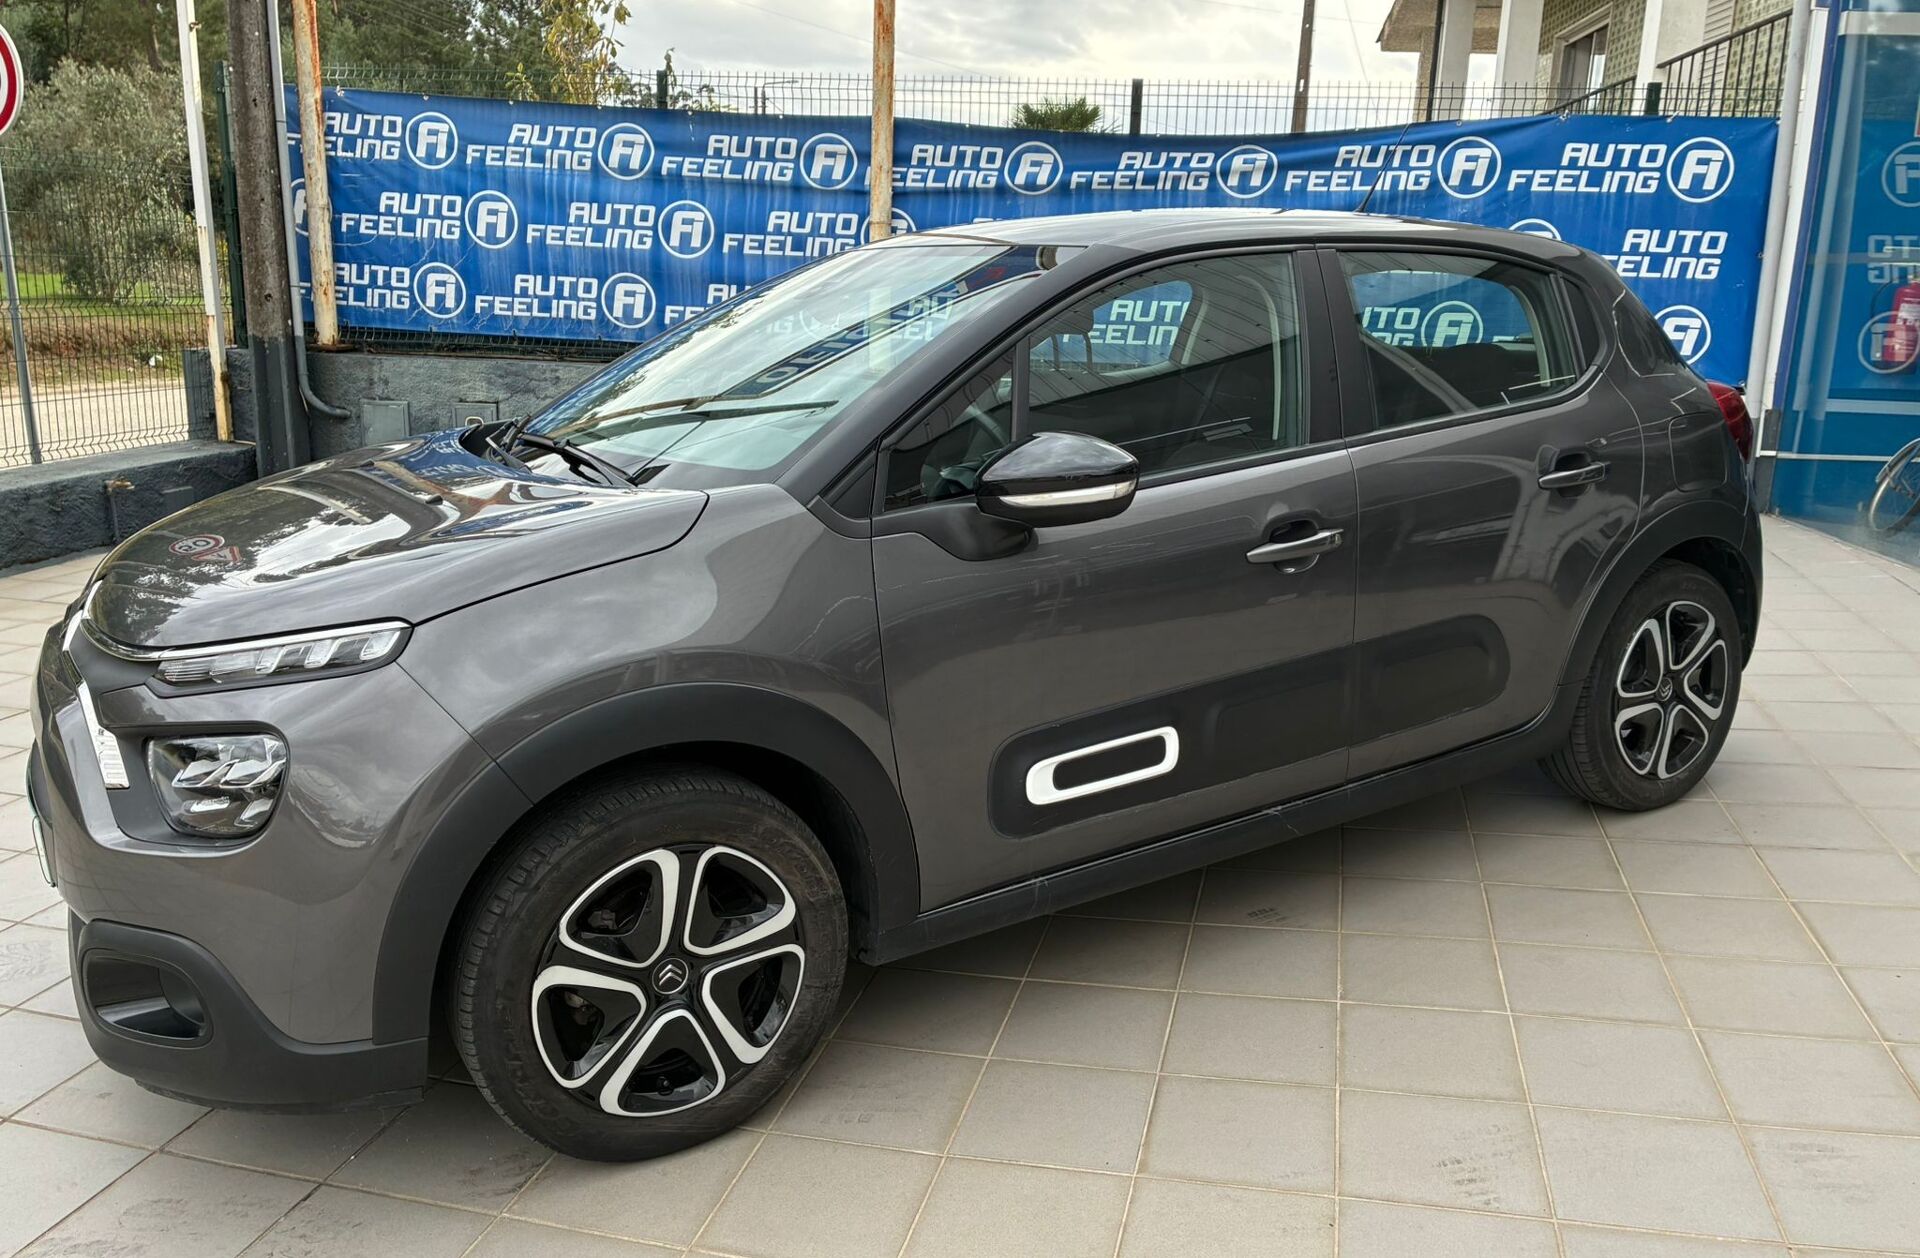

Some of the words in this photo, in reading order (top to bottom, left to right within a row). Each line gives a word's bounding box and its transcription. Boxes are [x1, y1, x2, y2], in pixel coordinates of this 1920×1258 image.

[324, 112, 402, 138] AUTO
[508, 123, 597, 148] AUTO
[465, 144, 593, 171] FEELING
[707, 134, 798, 160] AUTO
[910, 144, 1004, 169] AUTO
[1334, 144, 1436, 168] AUTO
[1560, 142, 1667, 169] AUTO
[661, 156, 795, 182] FEELING
[1118, 151, 1215, 170] AUTO
[1070, 170, 1210, 191] FEELING
[1284, 169, 1432, 192] FEELING
[1507, 169, 1661, 194] FEELING
[379, 191, 462, 217] AUTO
[568, 201, 656, 227] AUTO
[341, 213, 461, 241] FEELING
[767, 210, 859, 235] AUTO
[526, 223, 653, 250] FEELING
[1622, 229, 1728, 255] AUTO
[335, 263, 410, 288] AUTO
[1601, 254, 1722, 280] ELING
[514, 274, 599, 299] AUTO
[475, 295, 597, 321] FEELING
[1110, 300, 1190, 322] AUT
